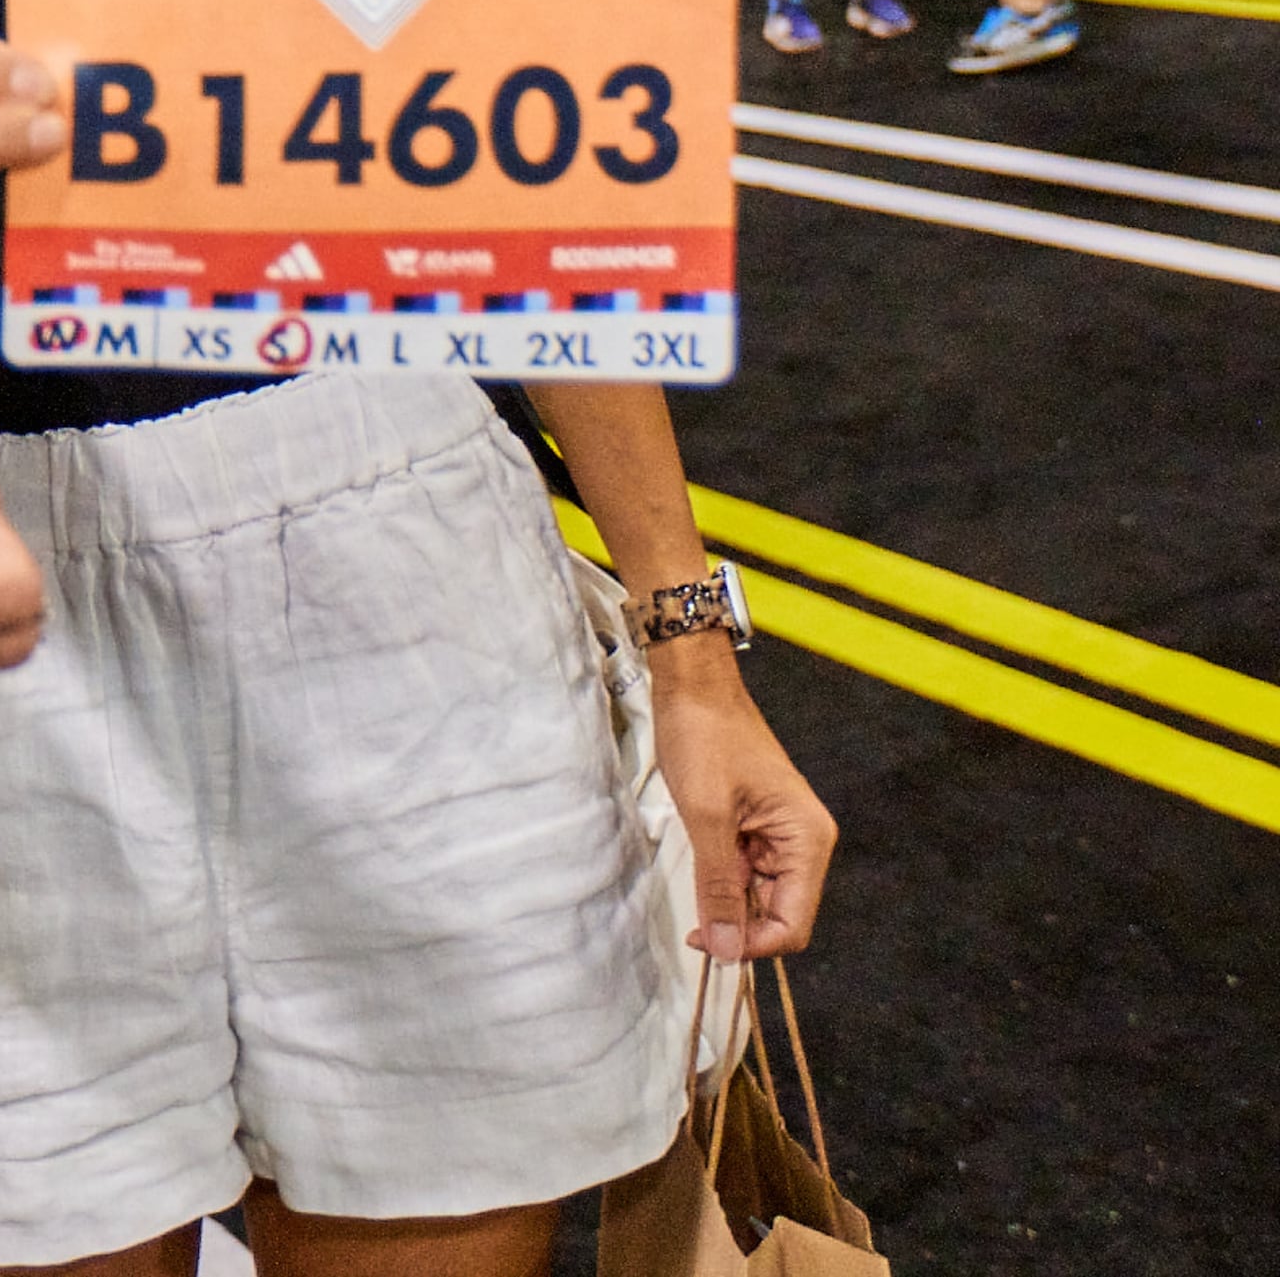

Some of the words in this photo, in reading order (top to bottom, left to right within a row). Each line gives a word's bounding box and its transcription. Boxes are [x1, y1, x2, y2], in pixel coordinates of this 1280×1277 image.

[70, 61, 680, 188] B14603
[95, 323, 139, 356] M
[181, 327, 232, 360] XS
[323, 331, 360, 364] M
[392, 332, 409, 365] L
[444, 332, 490, 366] XL
[526, 332, 598, 368] 2XL
[632, 332, 706, 369] 3XL
